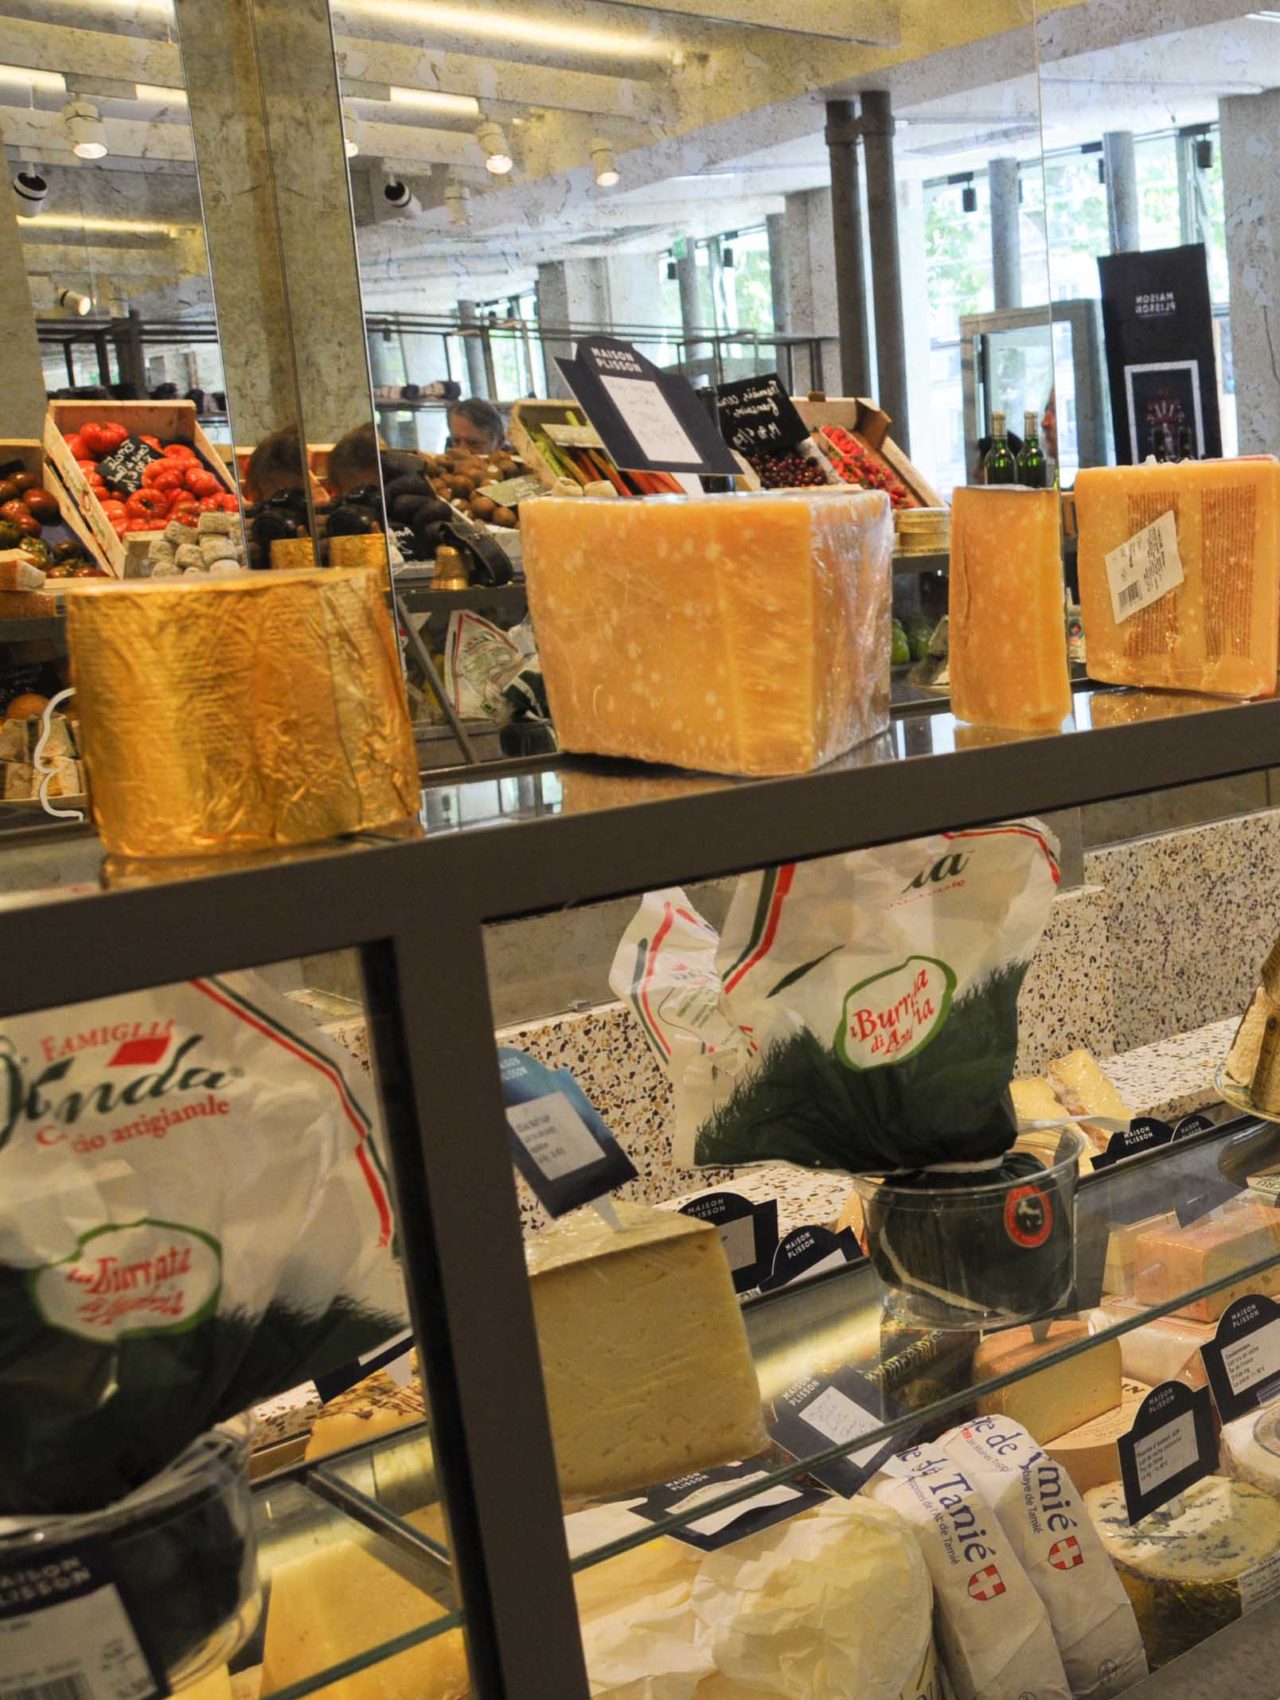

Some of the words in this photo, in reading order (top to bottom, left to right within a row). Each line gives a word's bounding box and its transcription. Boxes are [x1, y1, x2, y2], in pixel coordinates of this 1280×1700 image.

[591, 347, 635, 363] MAISON
[596, 358, 642, 374] PLISSON
[1123, 1126, 1151, 1139] MAISON
[1124, 1132, 1154, 1146] PLISSON
[688, 1199, 724, 1214] MAISON
[786, 1231, 811, 1251] MAISON
[787, 1239, 815, 1259] PLISSON
[1231, 1304, 1257, 1321] MAISON
[1232, 1310, 1260, 1328] PLISSON
[781, 1376, 813, 1400] MAISON
[790, 1379, 820, 1407] PLISSON
[1148, 1387, 1173, 1405] MAISON
[1149, 1395, 1175, 1414] PLISSON
[985, 1431, 1025, 1456] de
[664, 1471, 701, 1489] MAISON
[671, 1474, 710, 1492] PLISSON
[0, 1556, 81, 1589] AISON
[0, 1566, 91, 1608] LISSON
